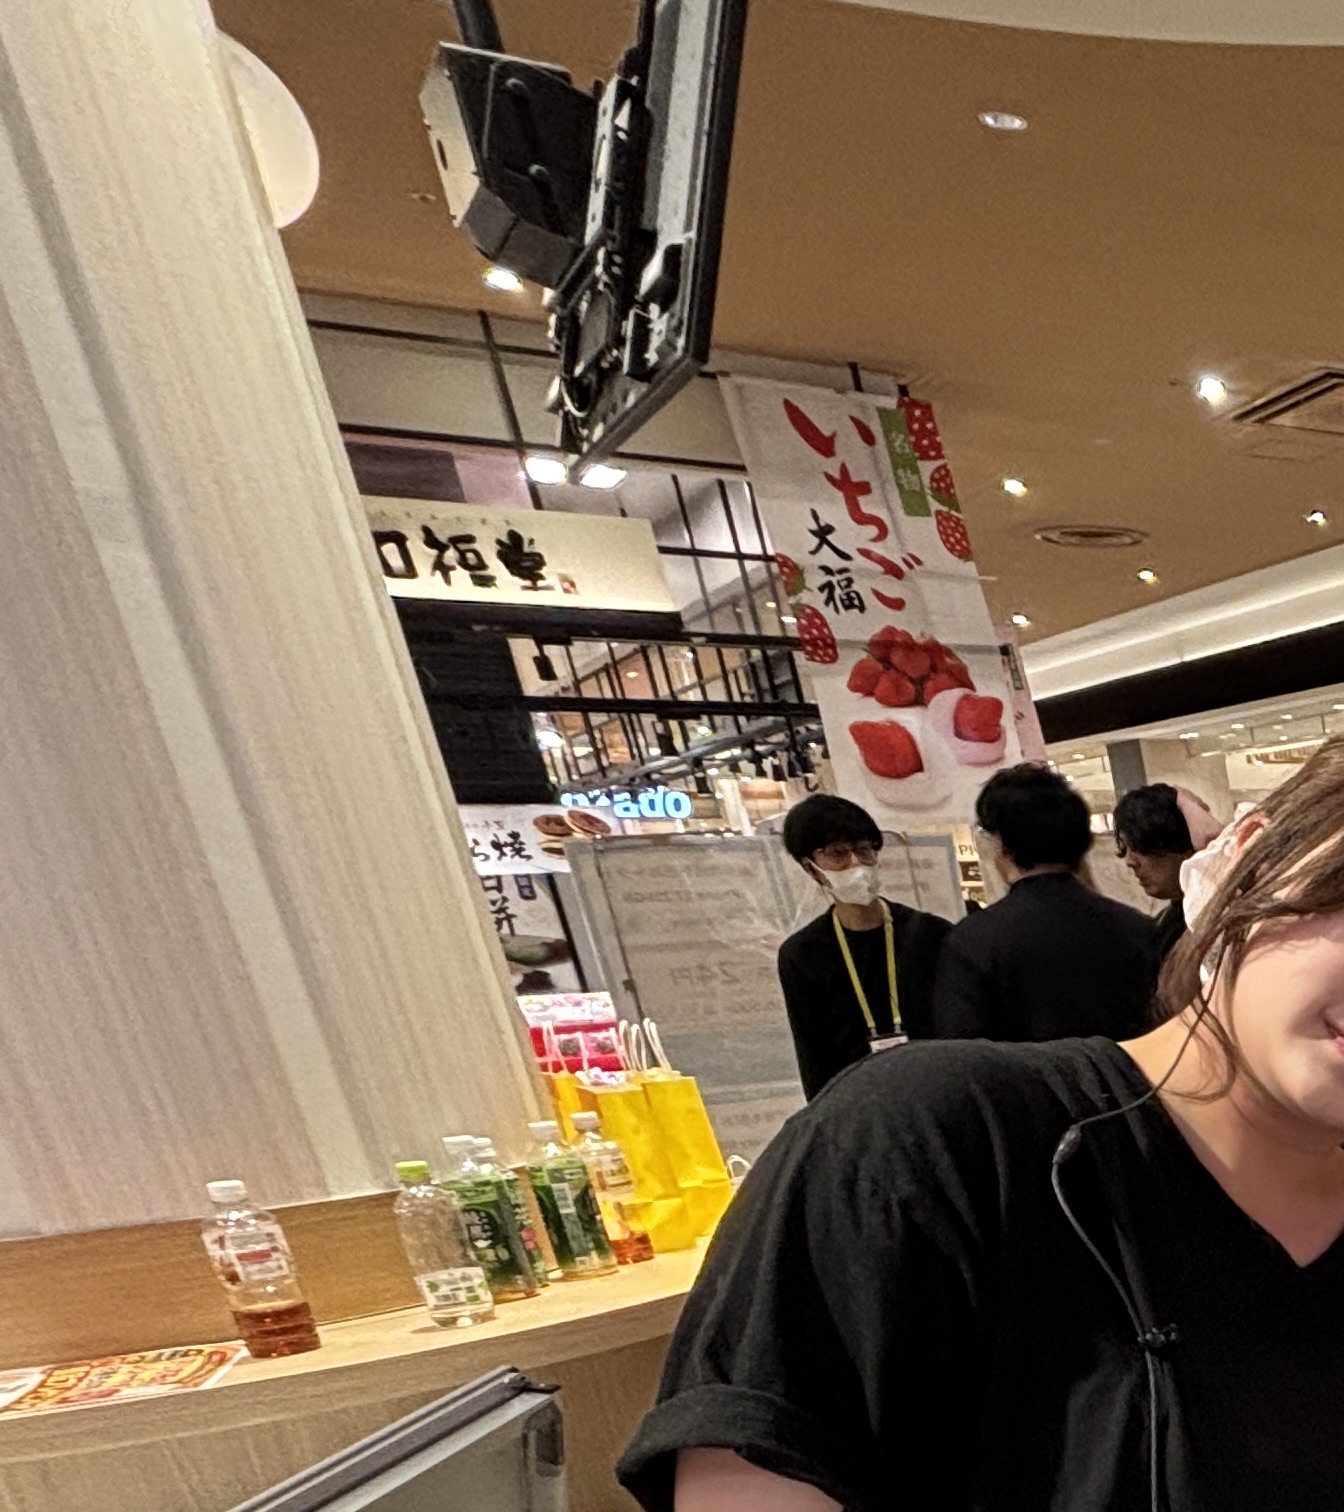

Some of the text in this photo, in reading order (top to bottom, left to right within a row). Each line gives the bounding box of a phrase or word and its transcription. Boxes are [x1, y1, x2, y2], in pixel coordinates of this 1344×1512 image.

[783, 397, 924, 612] いちご
[807, 507, 867, 615] 大福
